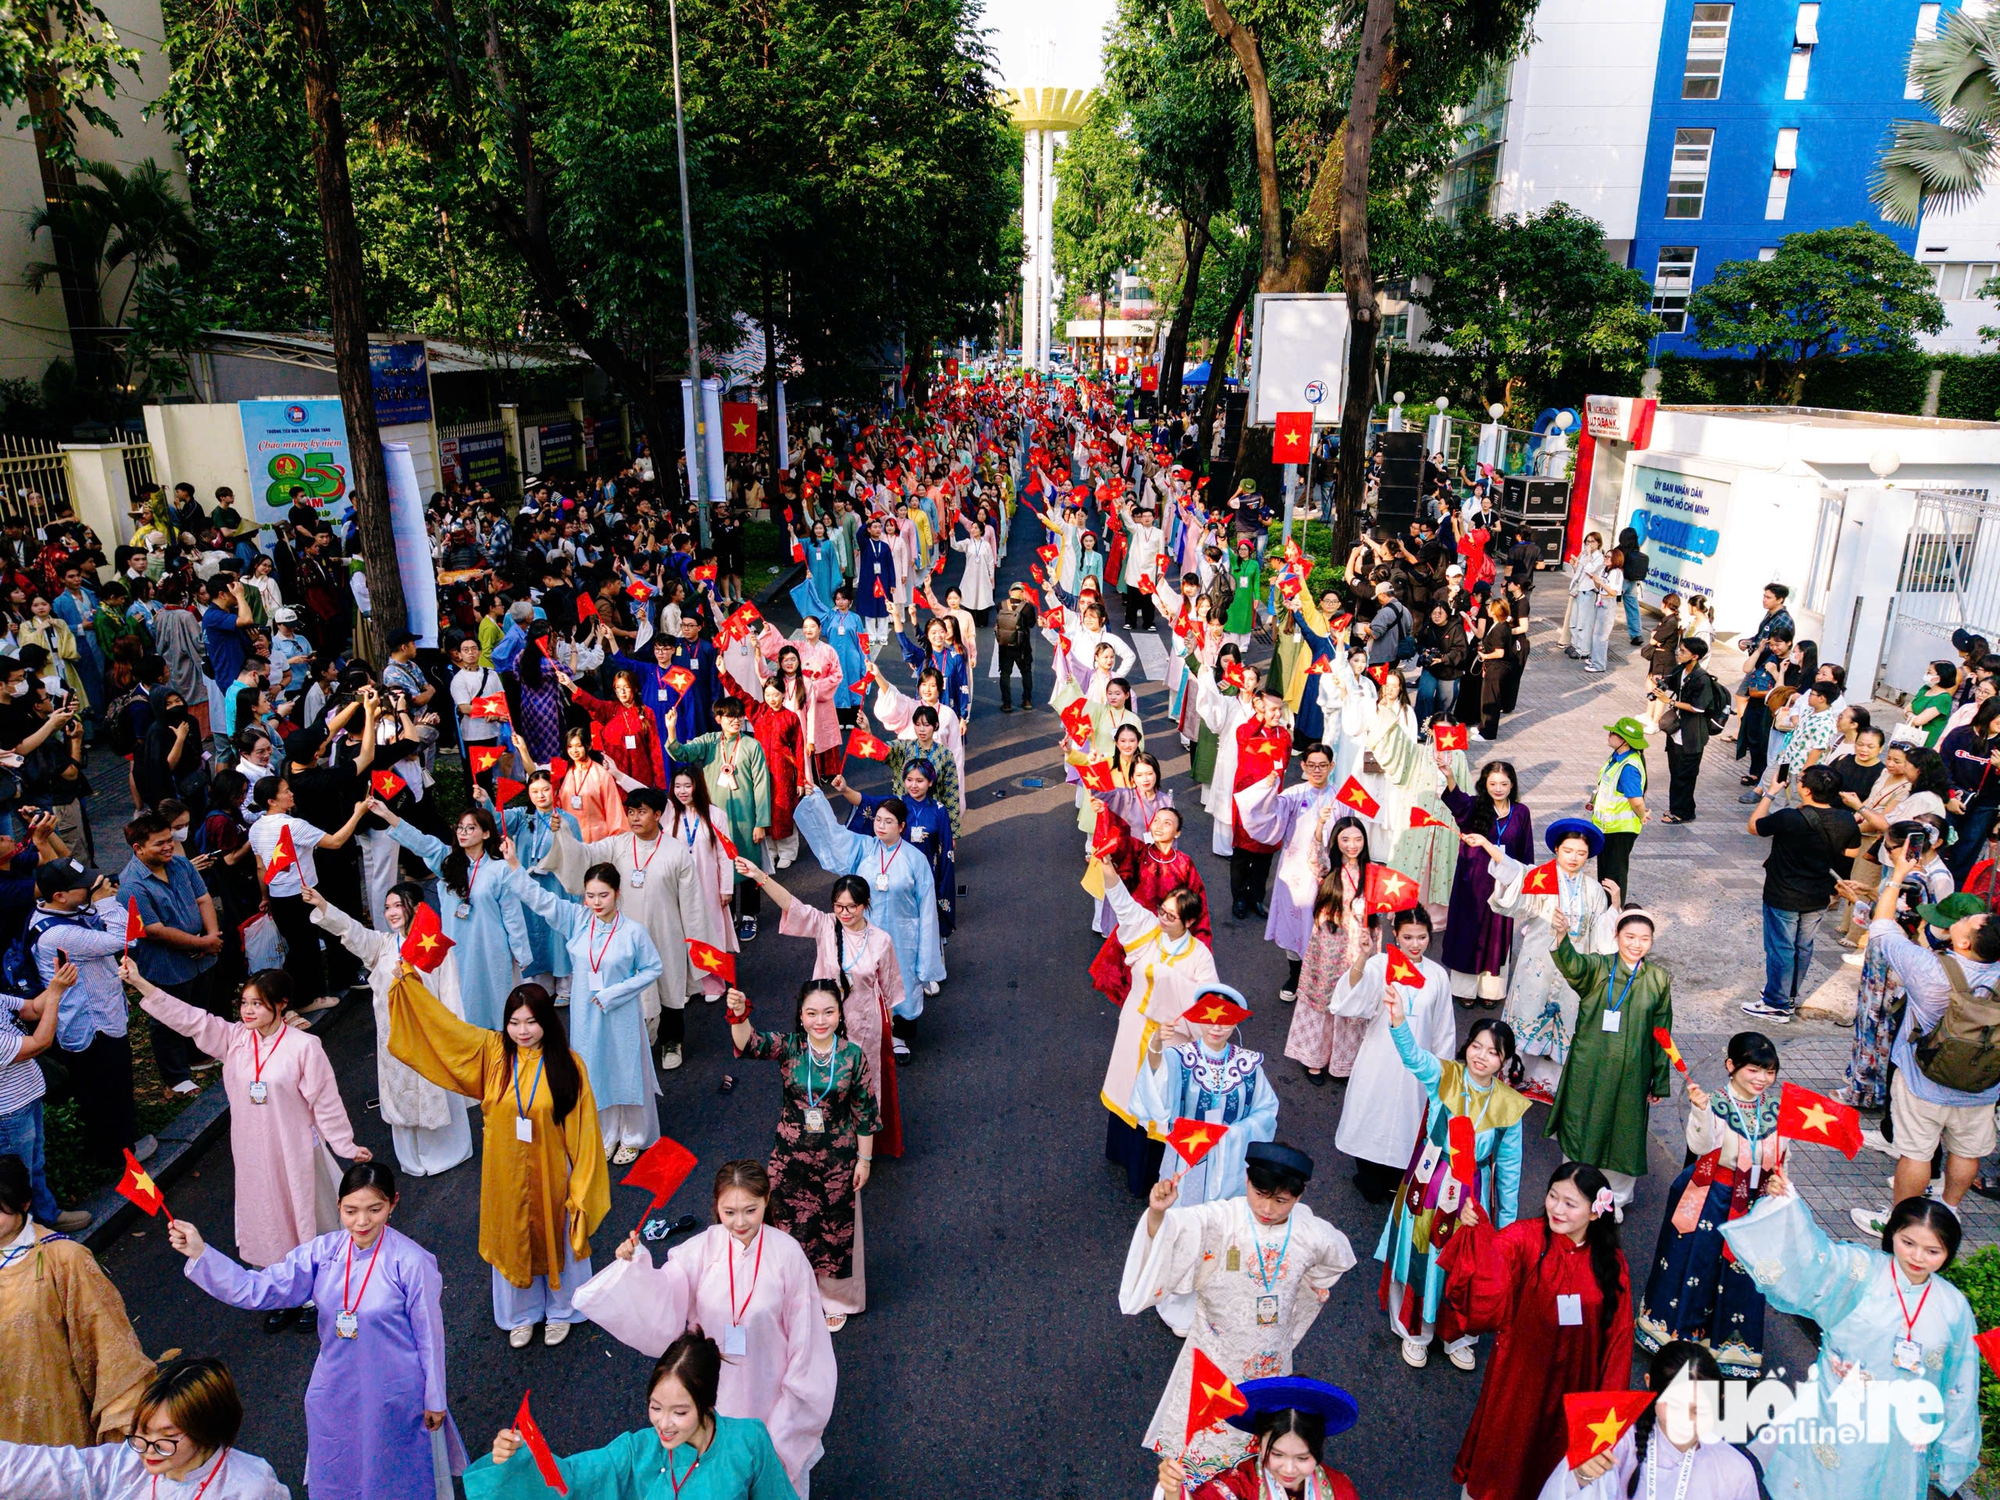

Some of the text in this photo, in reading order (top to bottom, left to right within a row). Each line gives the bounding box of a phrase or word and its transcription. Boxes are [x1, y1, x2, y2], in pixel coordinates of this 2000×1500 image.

[258, 440, 280, 452] Chào
[265, 452, 346, 508] 85
[1654, 478, 1704, 499] ỦY BAN NHÂN DÂN
[1645, 493, 1710, 516] THÀNH PHỐ HỒ CHÍ MINH
